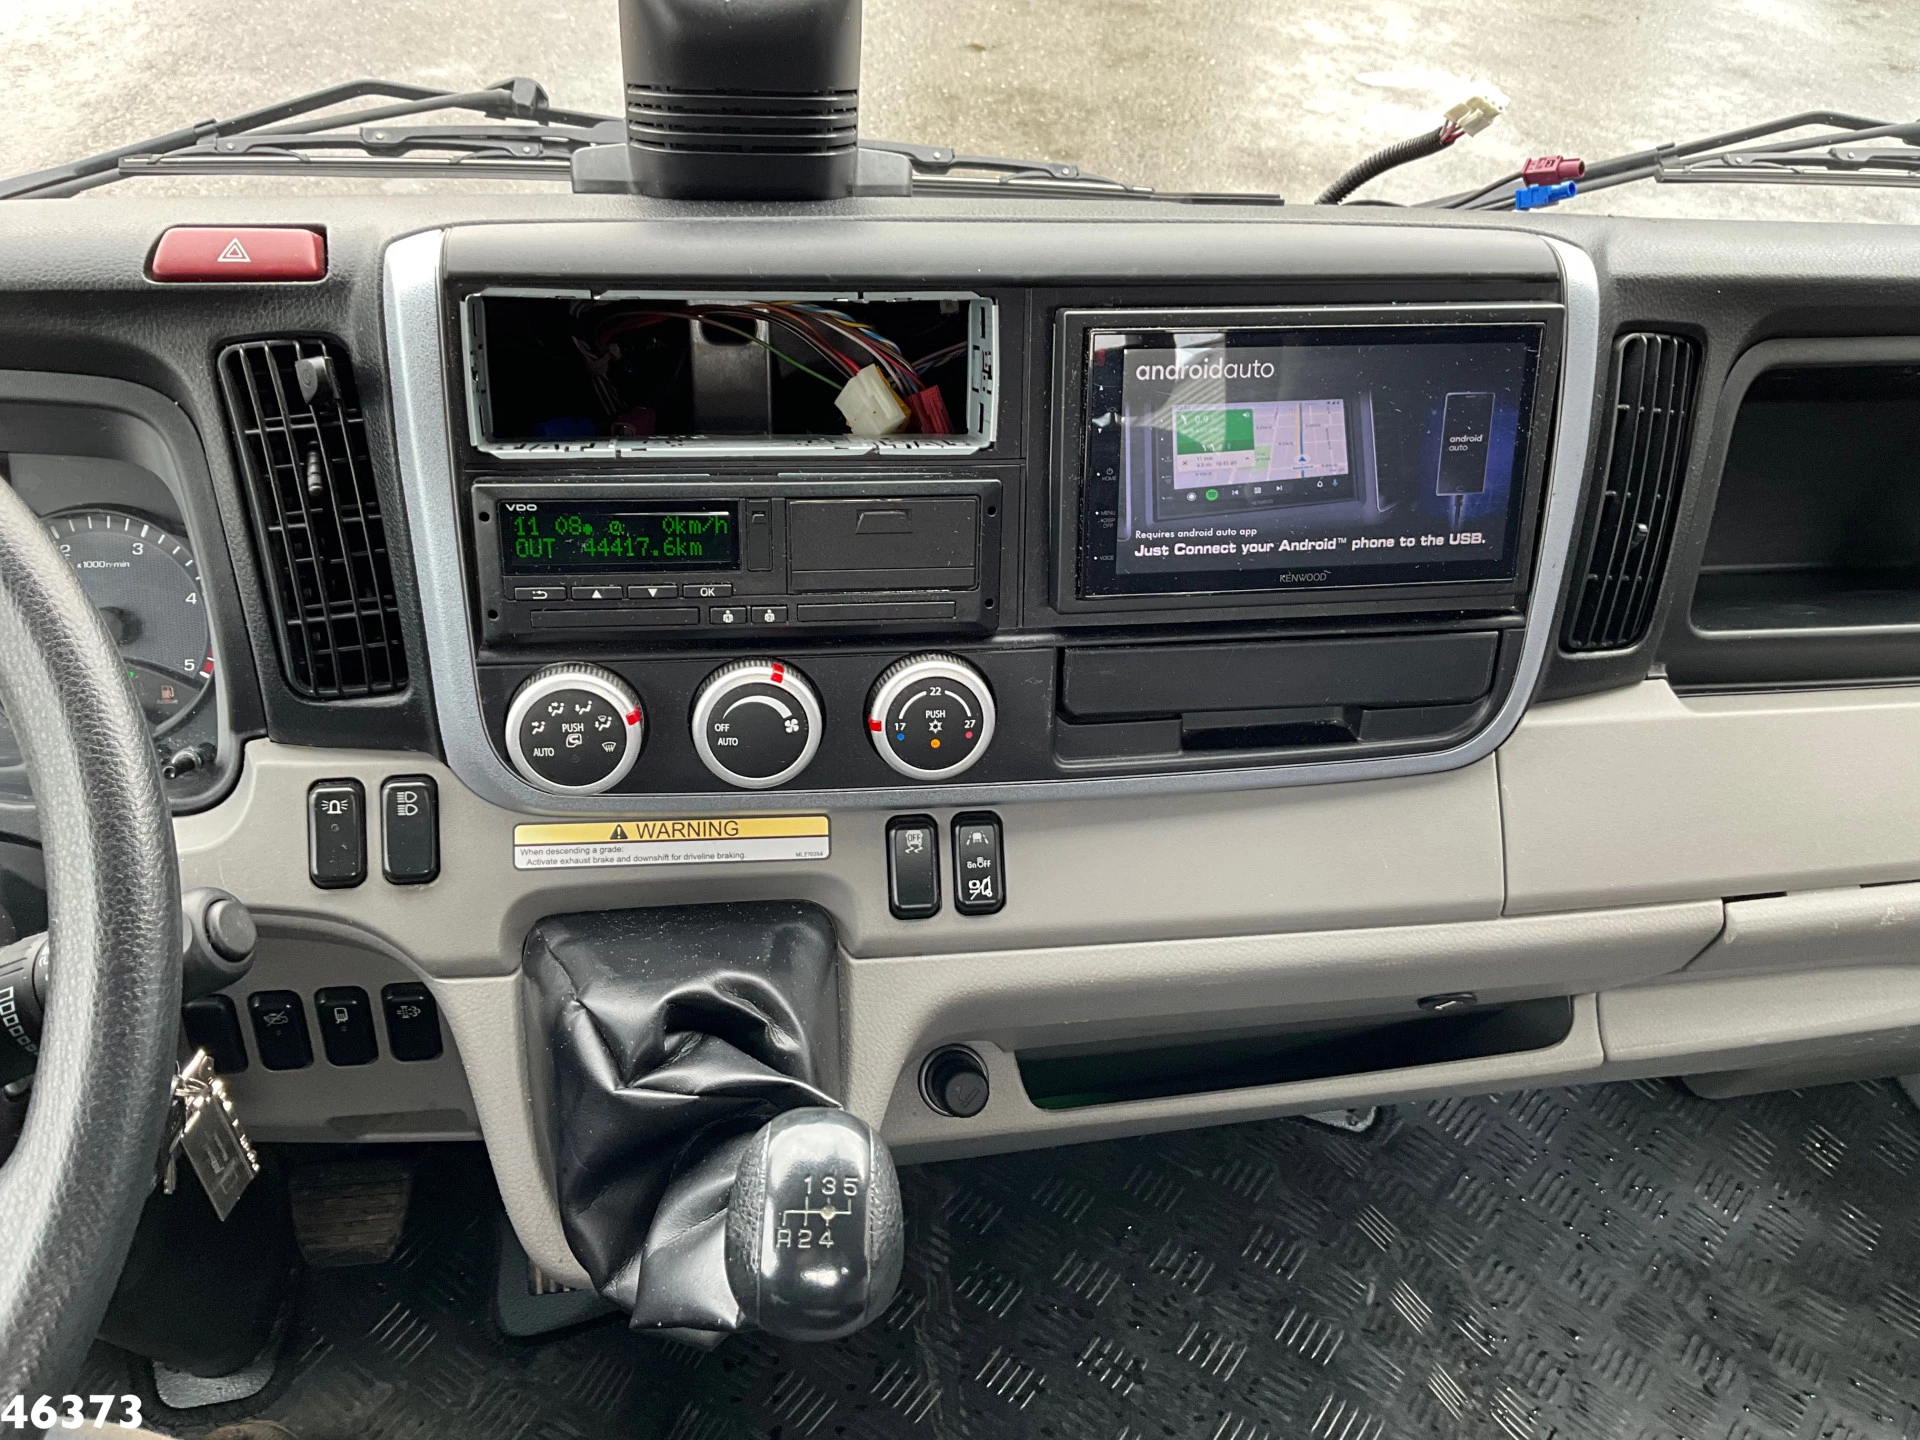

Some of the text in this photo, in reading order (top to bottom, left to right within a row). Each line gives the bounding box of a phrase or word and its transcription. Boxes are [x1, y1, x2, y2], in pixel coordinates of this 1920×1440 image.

[1135, 357, 1275, 381] androidauto
[1449, 434, 1483, 443] android
[1448, 444, 1469, 452] auto
[505, 503, 538, 512] VDO
[1135, 527, 1258, 540] Requires android auto app
[132, 543, 144, 555] 3
[515, 538, 555, 558] OUT
[1134, 544, 1170, 557] Just
[1174, 542, 1236, 556] Connect
[1241, 542, 1275, 555] your
[1351, 536, 1395, 551] phone
[1400, 535, 1416, 547] to
[1420, 534, 1445, 546] the
[1449, 532, 1486, 545] USB.
[1279, 572, 1327, 583] KENWOOD
[700, 587, 715, 597] OK
[185, 592, 197, 605] 4
[184, 659, 195, 671] 5
[929, 687, 942, 696] 22
[925, 710, 946, 718] PUSH
[562, 723, 584, 732] PUSH
[714, 723, 730, 732] OFF
[894, 723, 906, 731] 17
[964, 720, 976, 729] 27
[718, 737, 738, 746] AUTO
[533, 748, 554, 757] AUTO
[636, 820, 739, 840] WARNING
[907, 833, 921, 841] OFF
[520, 848, 543, 856] When
[545, 846, 590, 856] descending
[599, 846, 624, 855] grade:
[526, 857, 558, 866] Activate
[560, 857, 591, 865] exhaust
[592, 856, 614, 864] brake
[616, 855, 631, 863] and
[633, 853, 669, 862] downshift
[671, 853, 682, 861] for
[683, 853, 714, 861] driveline
[804, 1177, 858, 1196] 1 3 5
[797, 1230, 812, 1248] 2
[818, 1229, 834, 1248] 4
